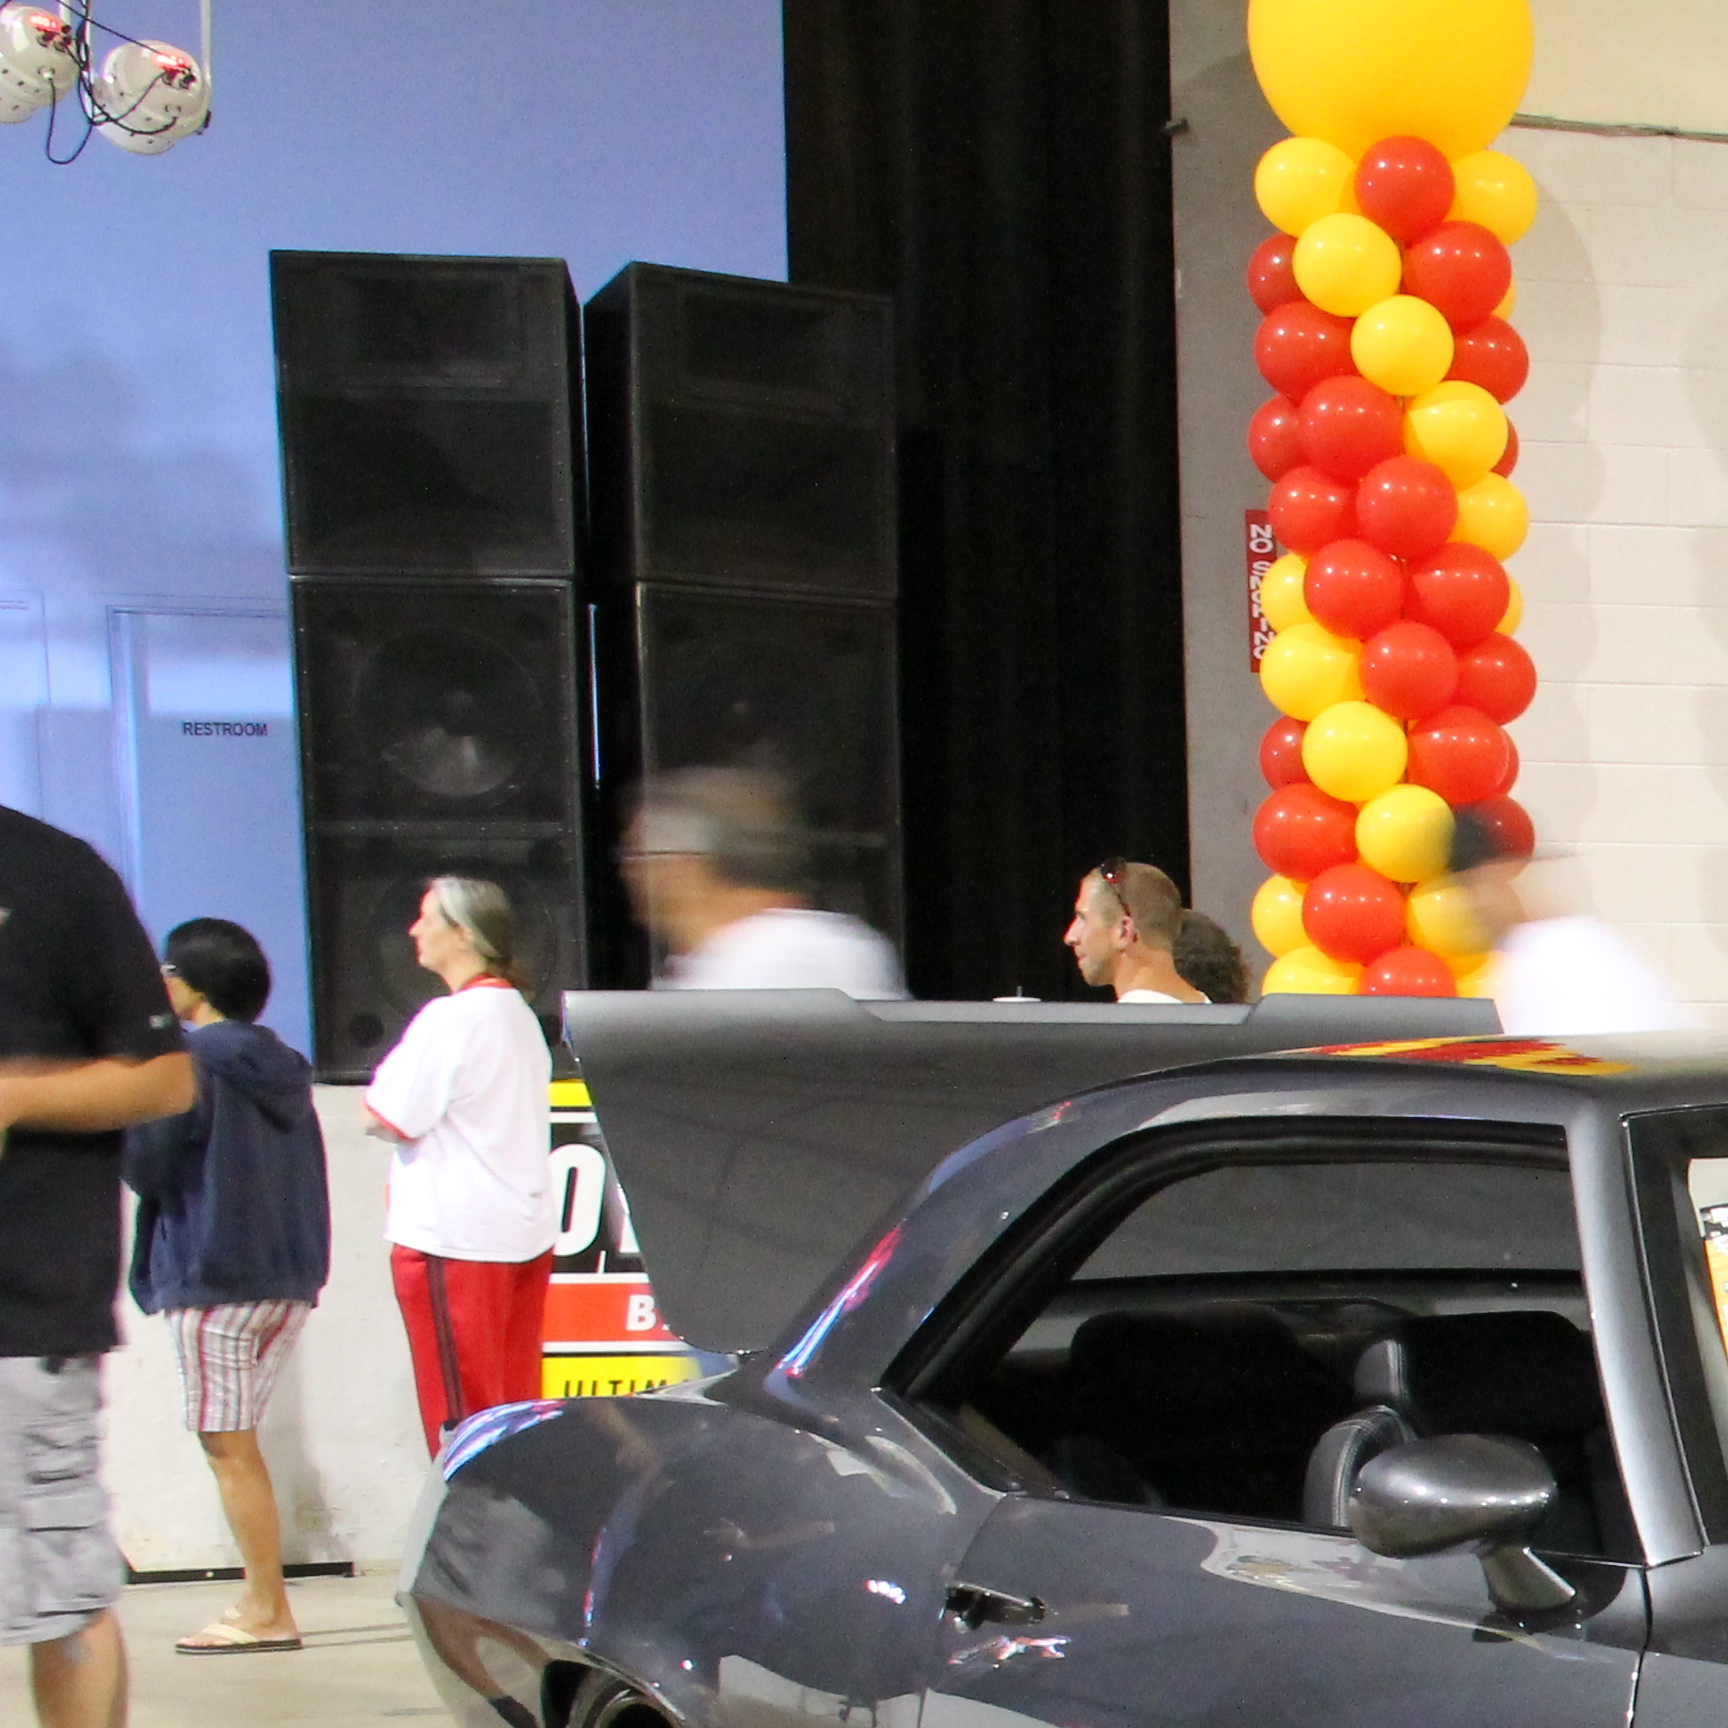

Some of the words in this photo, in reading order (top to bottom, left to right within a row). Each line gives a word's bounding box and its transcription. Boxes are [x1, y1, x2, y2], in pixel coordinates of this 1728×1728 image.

[1249, 523, 1274, 554] NO
[182, 721, 268, 736] RESTROOM
[563, 1379, 688, 1398] ULTIM
